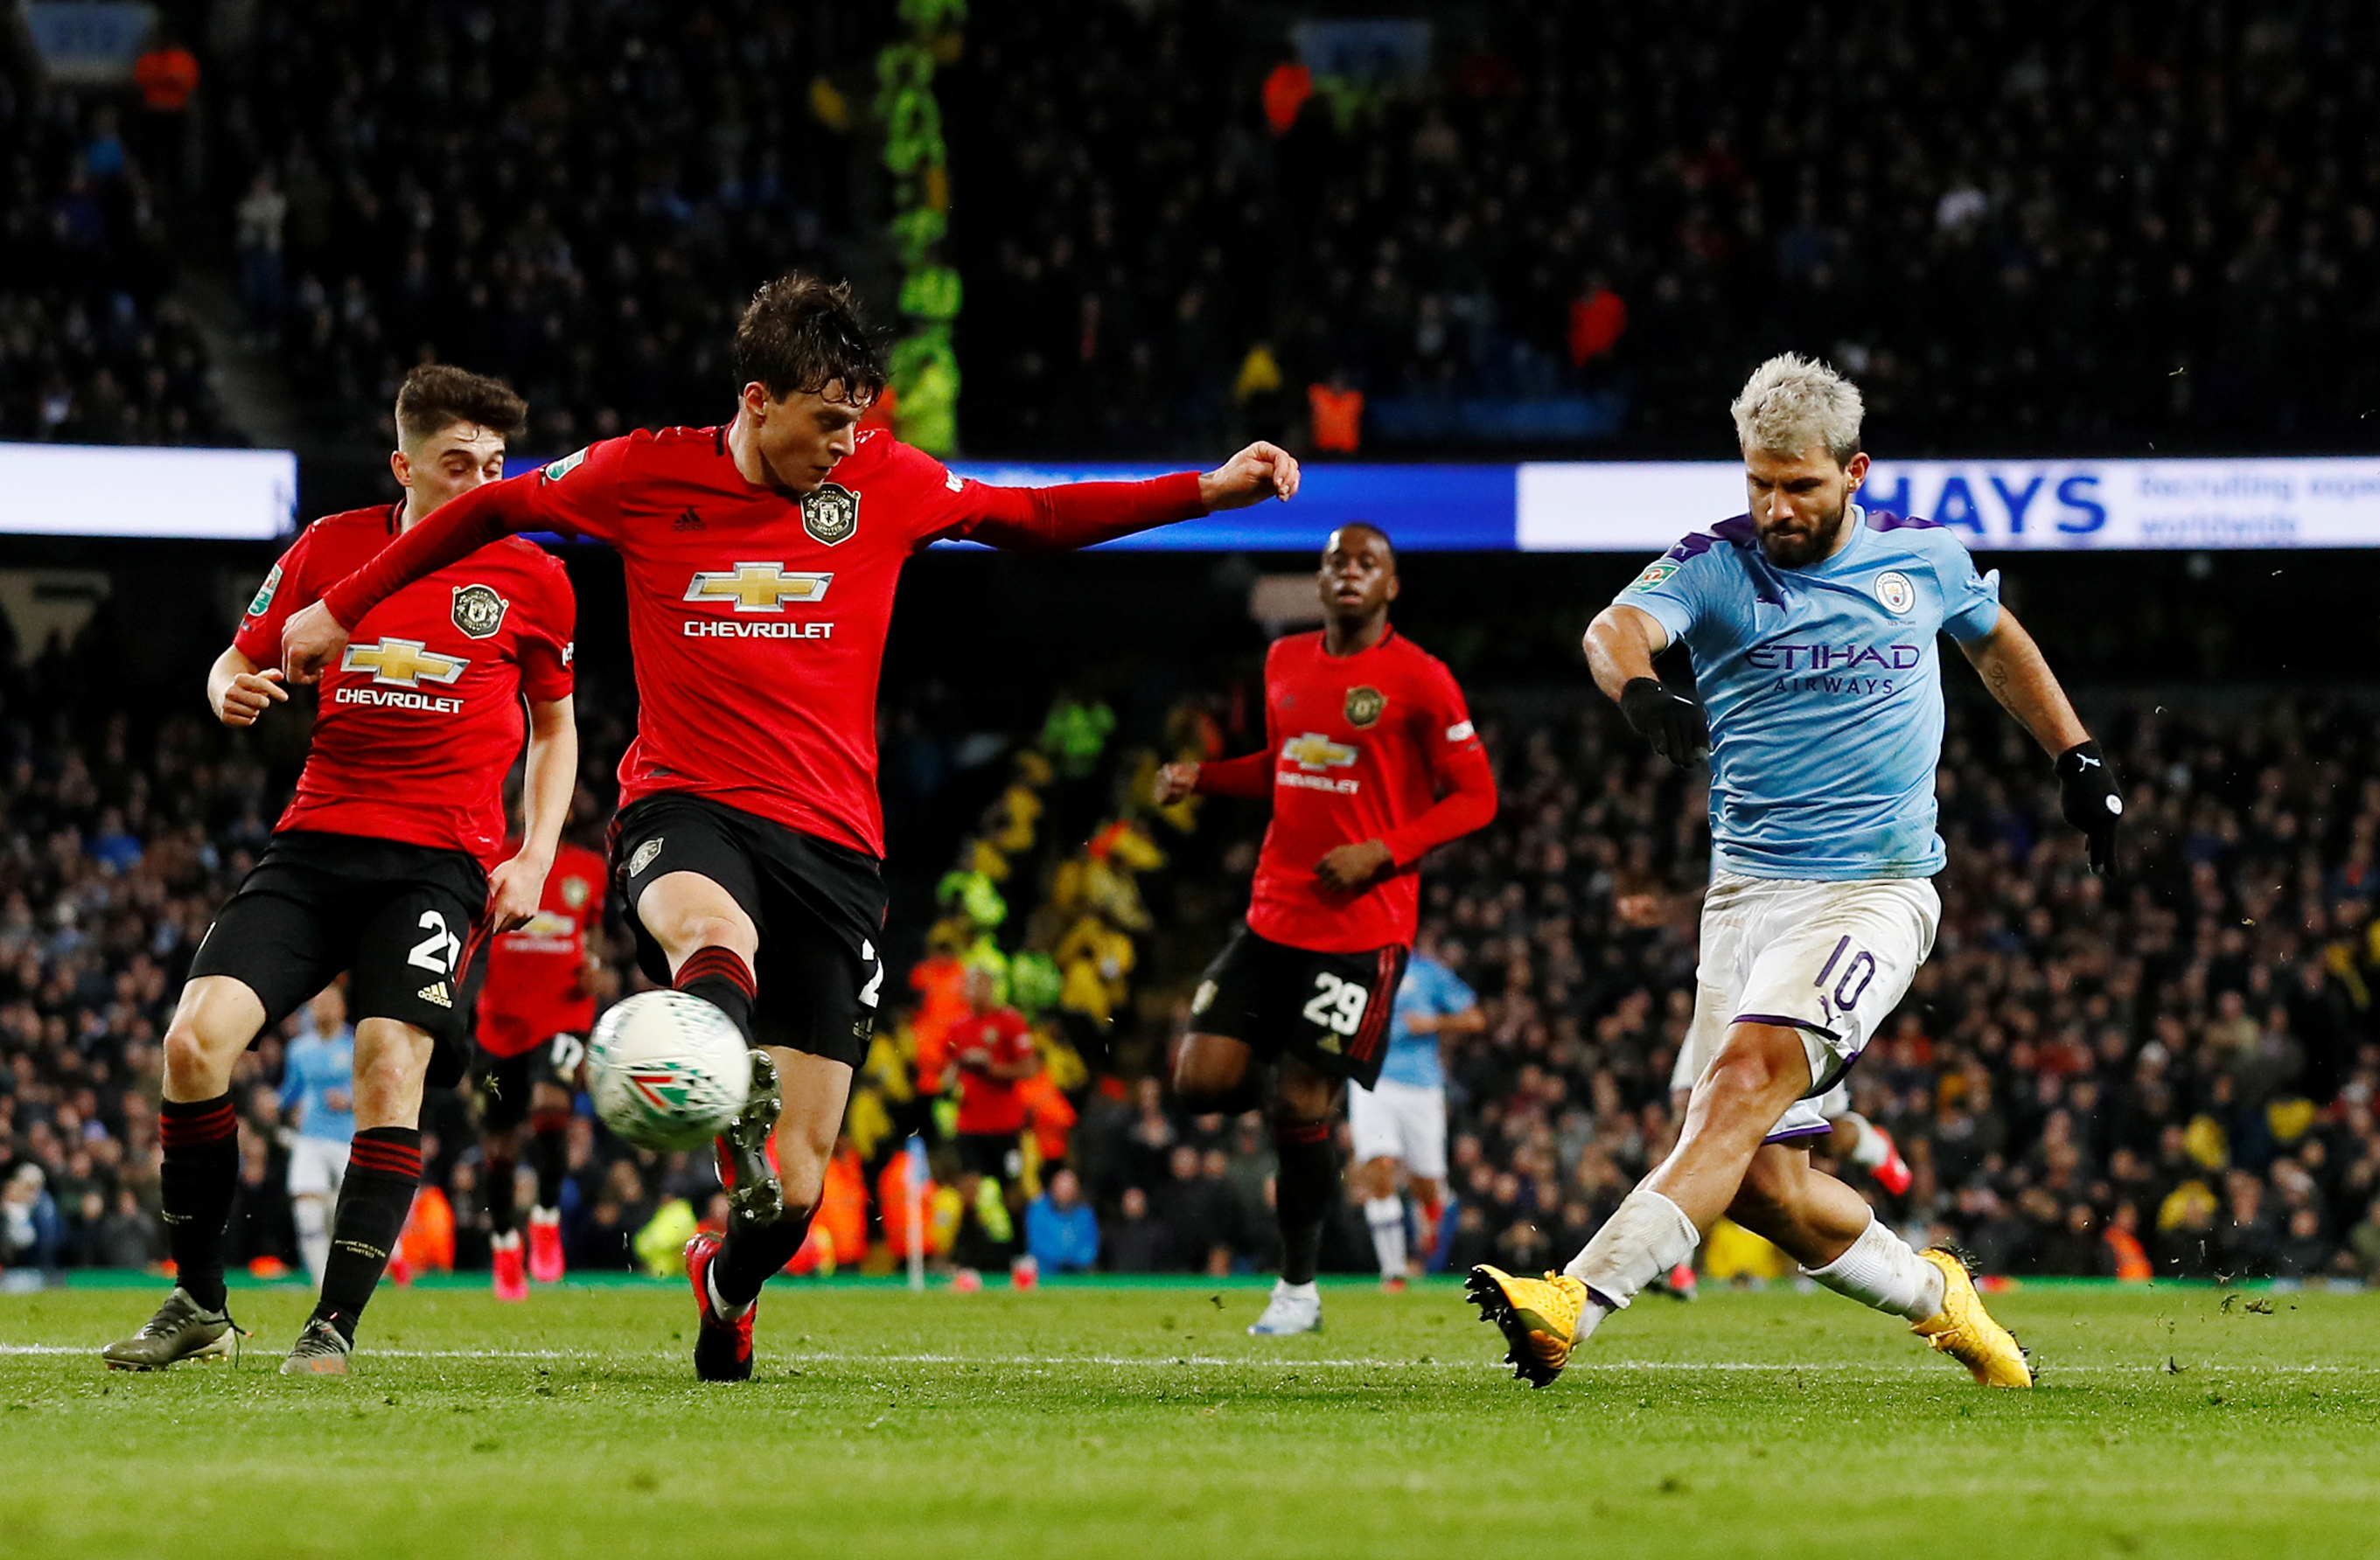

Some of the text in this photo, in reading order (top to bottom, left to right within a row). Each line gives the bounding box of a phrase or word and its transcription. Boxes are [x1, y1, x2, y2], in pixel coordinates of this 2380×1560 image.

[683, 621, 834, 639] CHEVROLET
[1746, 644, 1921, 670] ETIHAD
[1773, 677, 1894, 694] AIRWAYS
[335, 688, 464, 714] CHEVROLET
[1813, 934, 1875, 1011] 10
[417, 990, 453, 1008] adidas
[1302, 972, 1368, 1036] 29
[346, 1245, 375, 1259] UNITED
